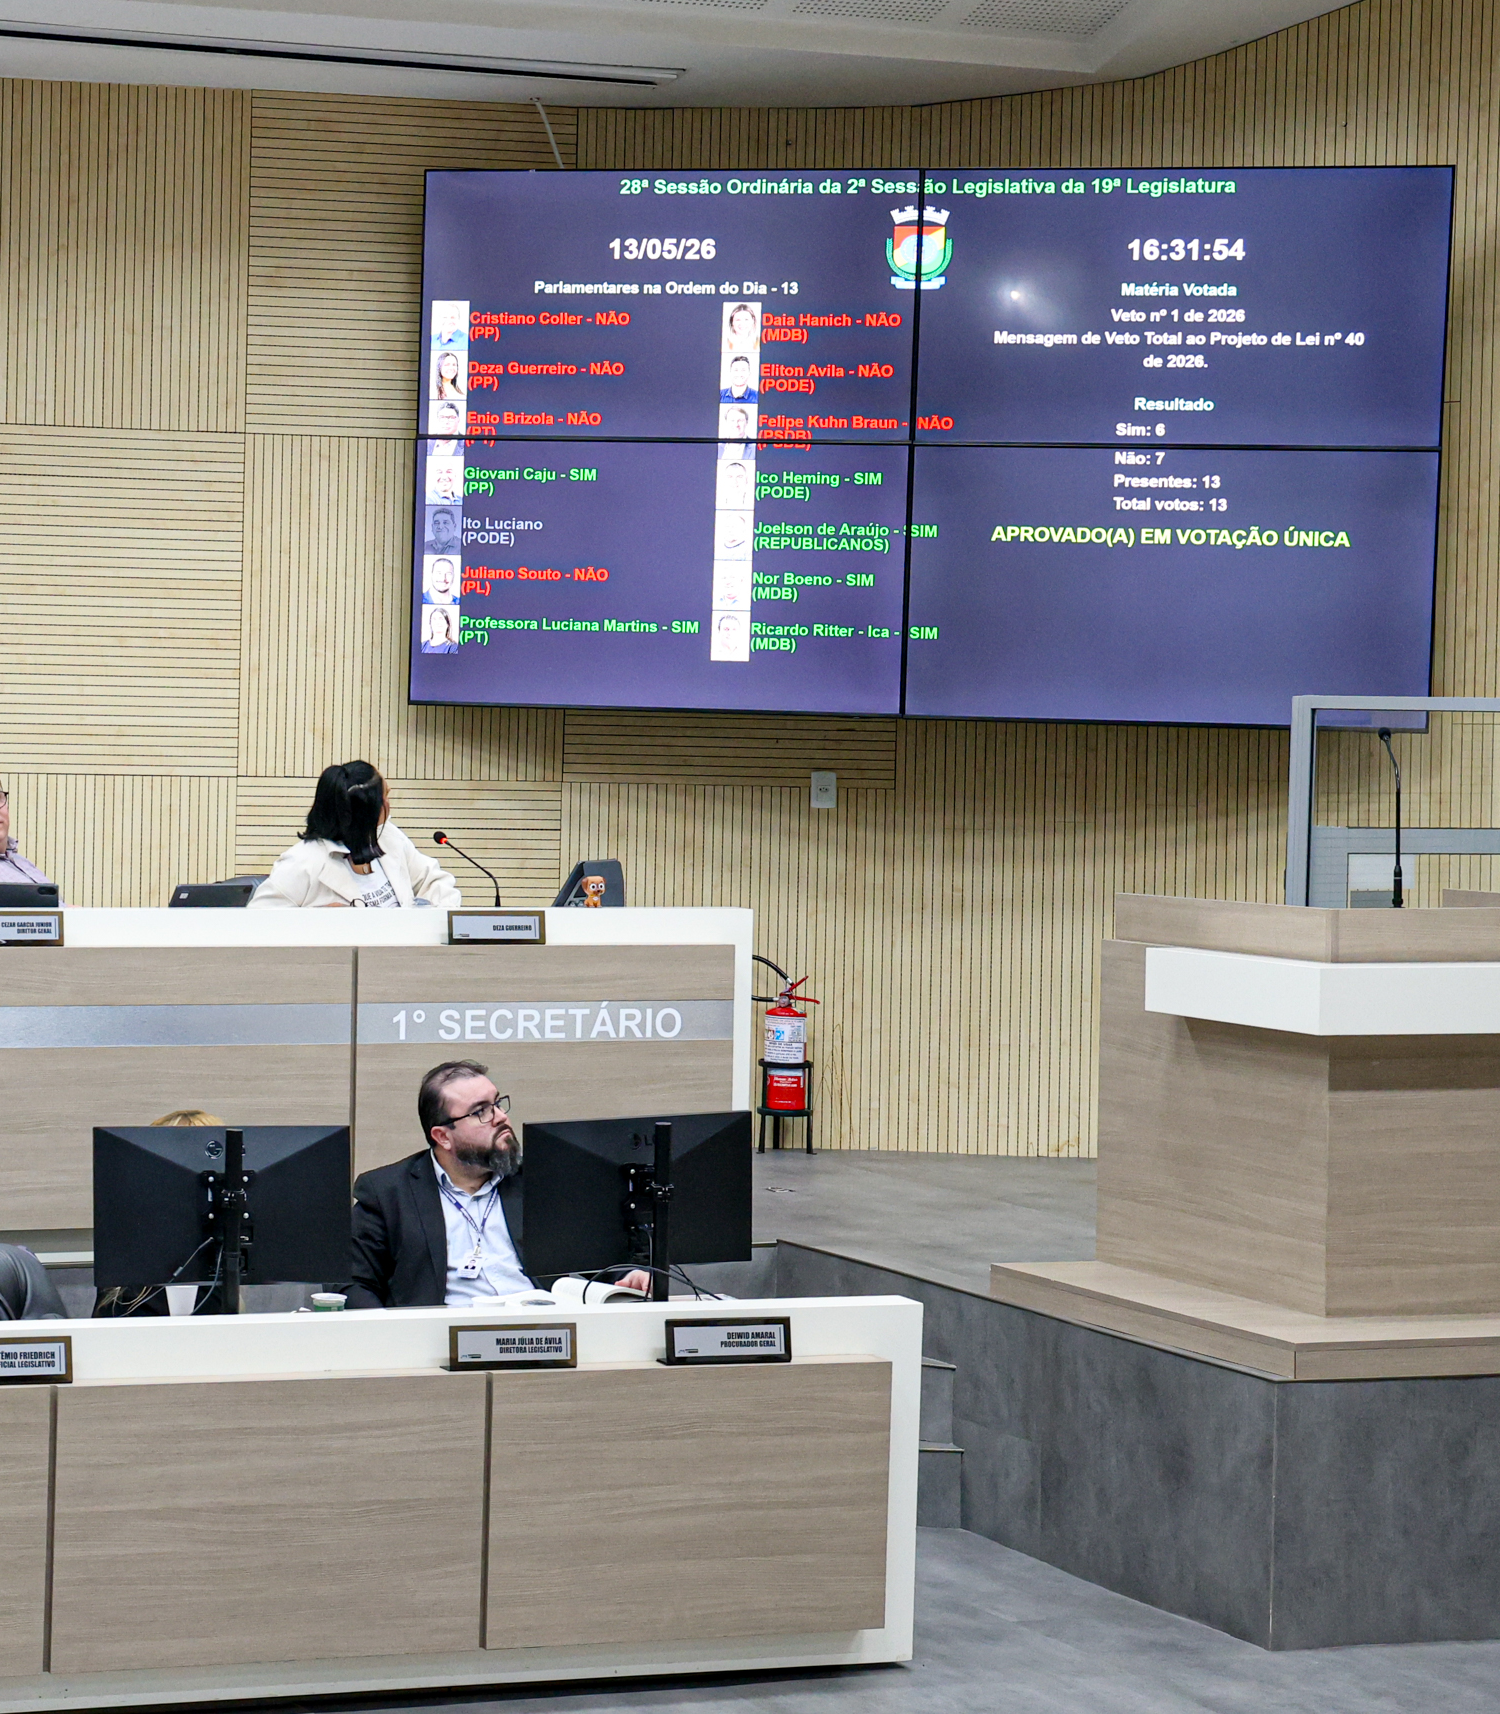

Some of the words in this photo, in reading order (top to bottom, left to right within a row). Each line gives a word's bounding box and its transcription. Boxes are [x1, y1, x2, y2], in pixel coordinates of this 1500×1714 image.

[619, 178, 649, 195] 28ª
[653, 178, 722, 195] Sessão
[726, 178, 814, 195] Ordinária
[818, 178, 842, 194] da
[846, 178, 866, 194] 2ª
[952, 178, 1056, 198] Legislativa
[1060, 178, 1085, 194] da
[1091, 177, 1122, 194] 19ª
[1126, 177, 1236, 198] Legislatura
[609, 237, 717, 260] 13/05/26
[1127, 238, 1246, 261] 16:31:54
[534, 280, 640, 295] Parlamentares
[643, 283, 662, 295] na
[665, 280, 716, 295] Ordem
[718, 281, 740, 295] do
[742, 281, 768, 295] Dia
[780, 281, 799, 295] 13
[1120, 281, 1179, 297] Matéria
[1182, 282, 1238, 297] Votada
[470, 312, 536, 325] Cristiano
[539, 312, 583, 325] Coller
[595, 311, 630, 325] NÃO
[762, 313, 795, 326] Daia
[799, 314, 852, 326] Hanich
[865, 312, 902, 327] NÃO
[1110, 308, 1147, 322] Veto
[1149, 308, 1168, 323] nº
[1170, 308, 1179, 323] 1
[1183, 308, 1205, 323] de
[1207, 308, 1246, 323] 2026
[470, 326, 500, 341] (PP)
[762, 328, 808, 344] (MDB)
[993, 330, 1078, 348] Mensagem
[1080, 330, 1102, 345] de
[1104, 331, 1141, 345] Veto
[1143, 331, 1183, 346] Total
[1185, 334, 1207, 346] ao
[1209, 331, 1268, 349] Projeto
[1270, 331, 1292, 346] de
[1295, 331, 1321, 346] Lei
[1323, 332, 1343, 346] nº
[1344, 332, 1365, 346] 40
[469, 361, 504, 374] Deza
[508, 362, 577, 374] Guerreiro
[590, 361, 625, 375] NÃO
[1142, 354, 1164, 368] de
[1166, 354, 1209, 369] 2026.
[761, 364, 802, 377] Eliton
[807, 364, 844, 377] Avila
[858, 363, 894, 378] NÃO
[468, 376, 499, 391] (PP)
[760, 379, 815, 394] (PODE)
[1134, 396, 1215, 412] Resultado
[467, 411, 500, 424] Enio
[503, 412, 554, 425] Brizola
[566, 411, 602, 426] NÃO
[759, 415, 807, 432] Felipe
[809, 416, 848, 428] Kuhn
[852, 416, 898, 429] Braun
[917, 415, 953, 430] NÃO
[1115, 422, 1152, 437] Sim:
[1154, 422, 1166, 437] 6
[1114, 451, 1152, 465] Não:
[1154, 451, 1166, 465] 7
[462, 465, 520, 482] Giovani
[523, 467, 557, 484] Caju
[569, 467, 597, 482] SIM
[755, 470, 779, 484] Ico
[782, 471, 840, 488] Heming
[853, 471, 882, 486] SIM
[1113, 473, 1198, 489] Presentes:
[1201, 474, 1221, 489] 13
[463, 481, 494, 497] (PP)
[753, 483, 810, 502] (PODE)
[1112, 496, 1152, 511] Total
[1154, 497, 1205, 512] votos:
[1208, 497, 1228, 512] 13
[462, 516, 481, 529] Ito
[485, 517, 543, 531] Luciano
[753, 521, 813, 536] Joelson
[816, 522, 836, 536] de
[838, 522, 890, 542] Araújo
[462, 531, 515, 547] (PODE)
[753, 535, 890, 554] (REPUBLICANOS)
[990, 525, 1135, 548] APROVADO(A)
[1140, 527, 1172, 545] EM
[1175, 525, 1279, 550] VOTAÇÃO
[1283, 525, 1351, 548] ÚNICA
[462, 566, 515, 579] Juliano
[518, 567, 562, 580] Souto
[574, 567, 609, 582] NÃO
[752, 571, 781, 585] Nor
[783, 572, 833, 586] Boeno
[845, 573, 875, 587] SIM
[461, 580, 491, 596] (PL)
[750, 586, 798, 603] (MDB)
[459, 615, 538, 630] Professora
[541, 617, 600, 632] Luciana
[603, 618, 659, 633] Martins
[670, 620, 700, 634] SIM
[750, 622, 809, 637] Ricardo
[812, 623, 855, 638] Ritter
[867, 624, 890, 639] Ica
[909, 626, 939, 640] SIM
[457, 628, 489, 646] (PT)
[749, 636, 797, 654] (MDB)
[437, 1001, 683, 1041] SECRETÁRIO
[517, 1336, 534, 1345] JÚLIA
[544, 1336, 562, 1345] ÁVILA
[19, 1351, 55, 1360] FRIEDRICH
[18, 1360, 55, 1368] LEGISLATIVO
